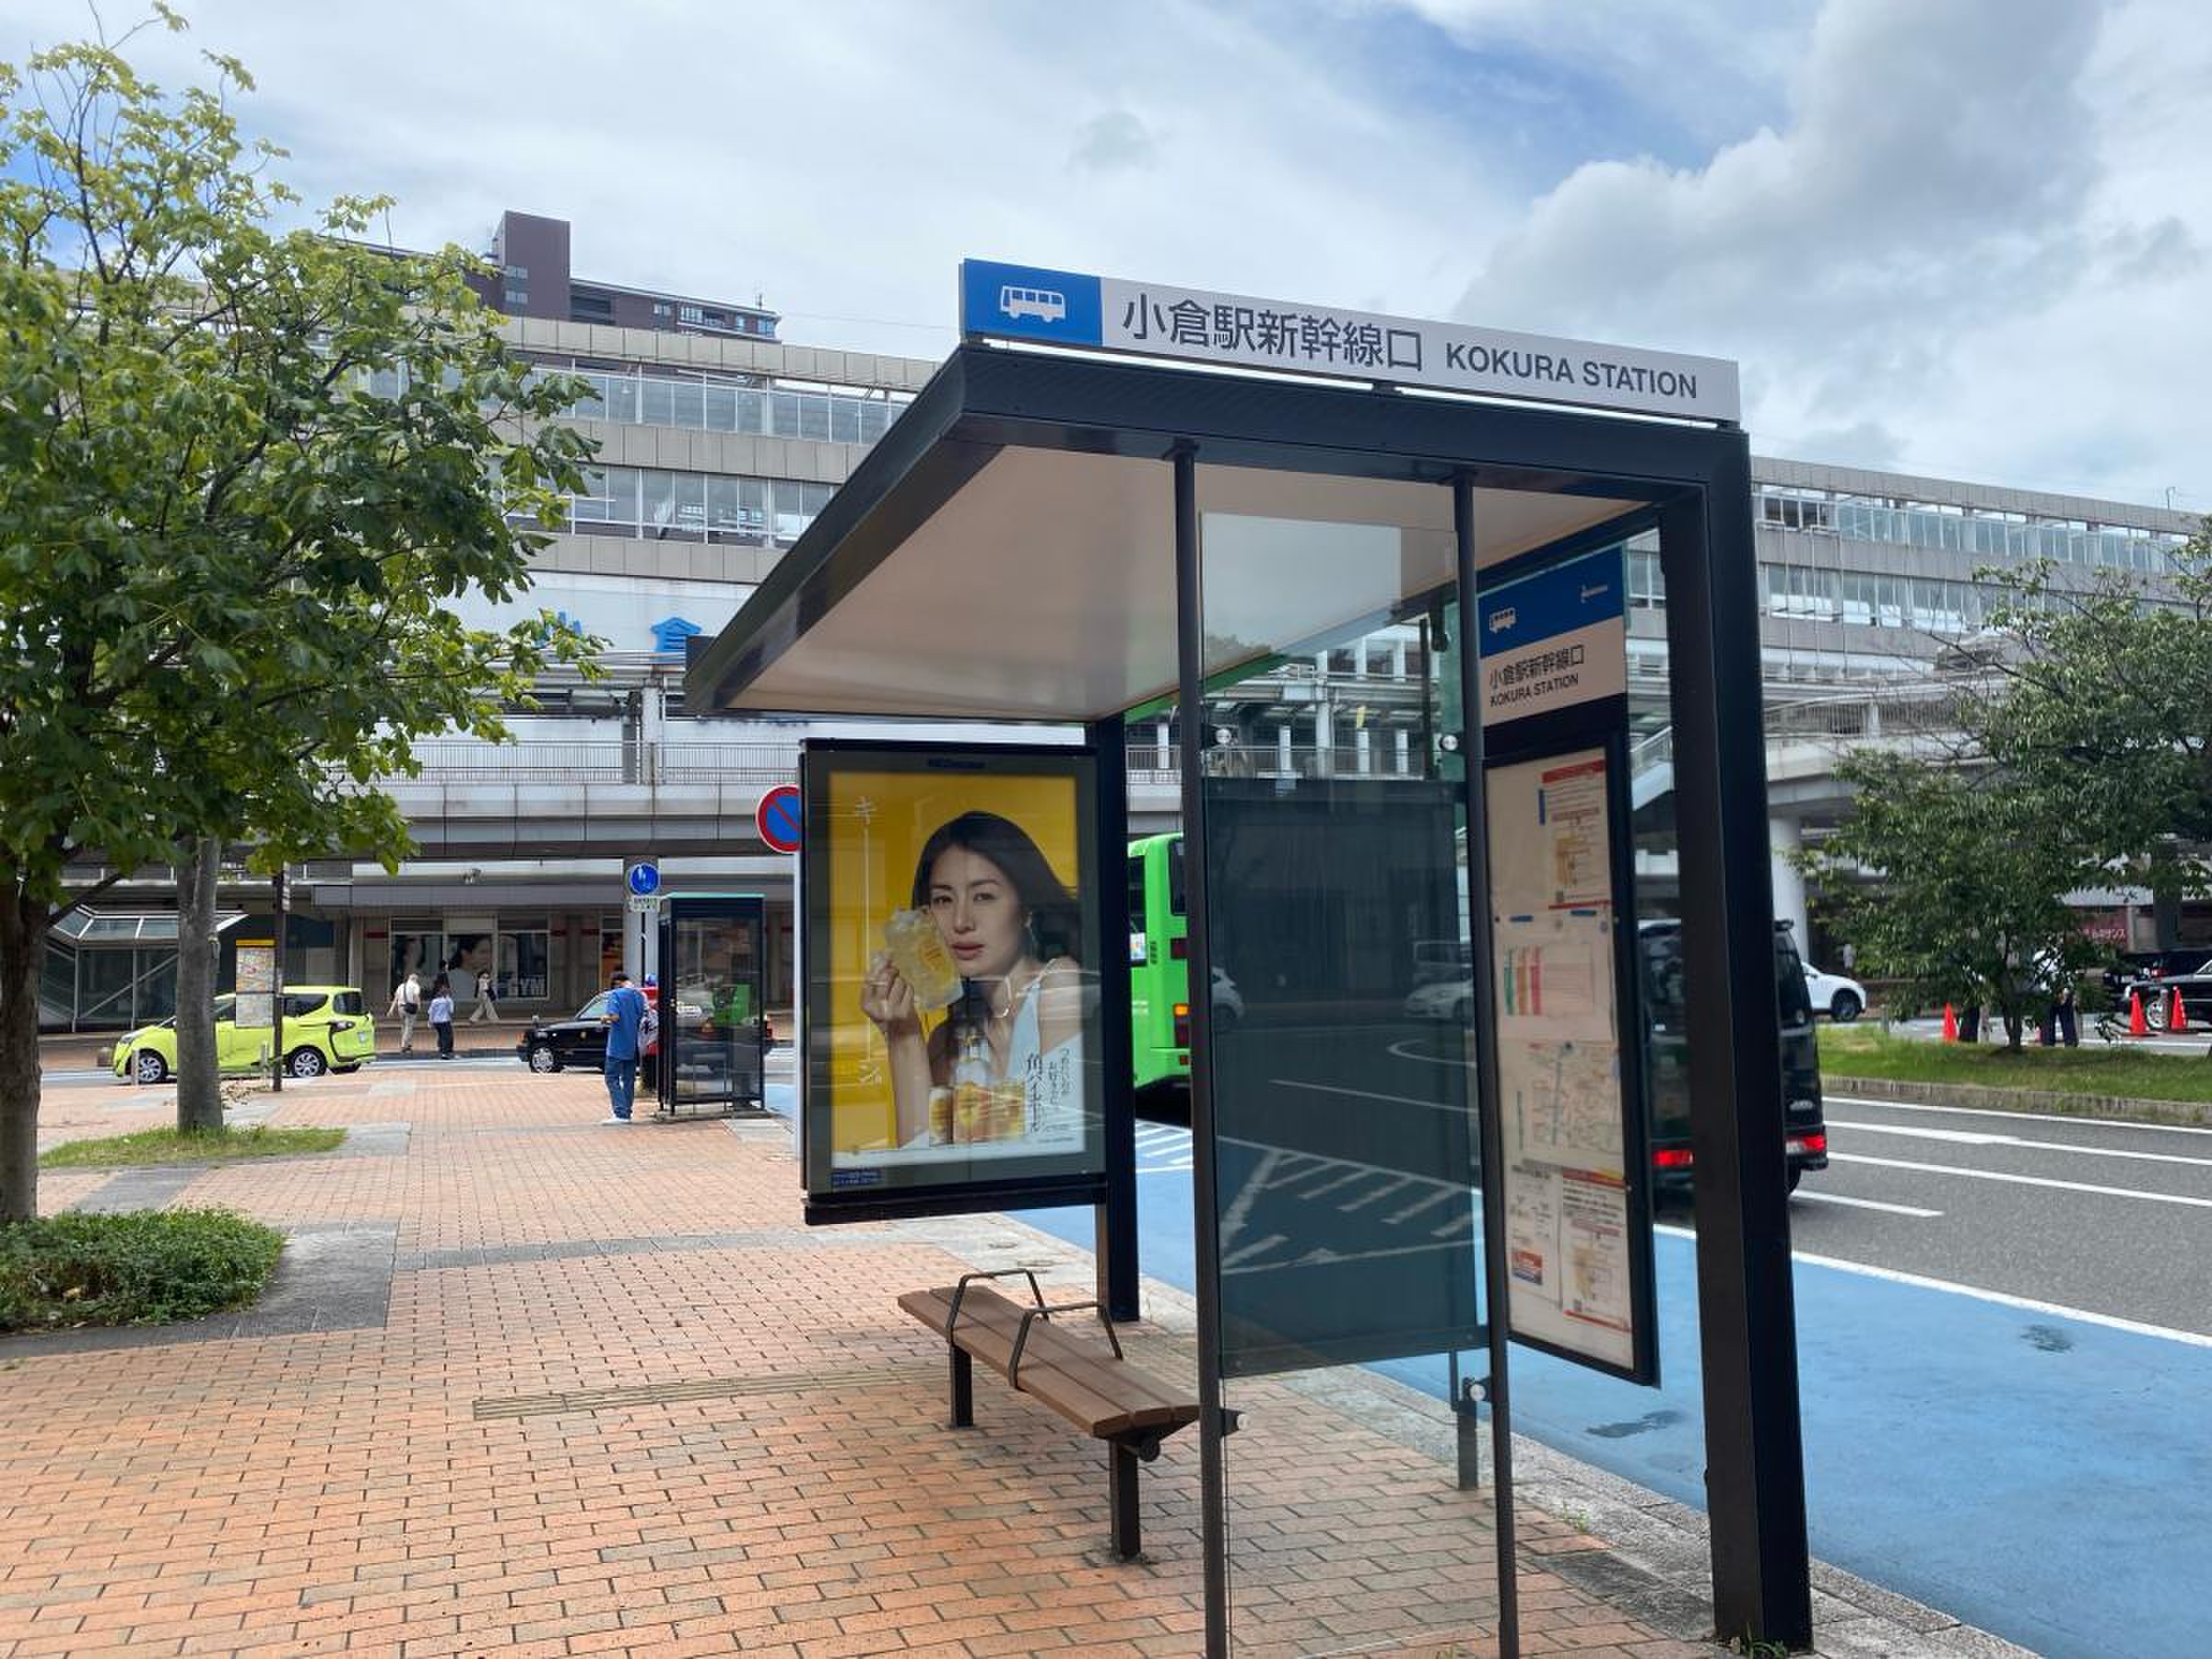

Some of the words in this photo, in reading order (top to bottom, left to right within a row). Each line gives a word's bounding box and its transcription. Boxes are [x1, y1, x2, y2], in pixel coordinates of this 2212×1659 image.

[1123, 292, 1422, 371] 小倉駅新幹線口
[1445, 342, 1574, 384] KOKURA
[1583, 360, 1697, 399] STATION
[1489, 644, 1584, 689] 小倉駅新幹線口
[1490, 685, 1532, 708] KOKURA
[1533, 673, 1579, 696] STATION
